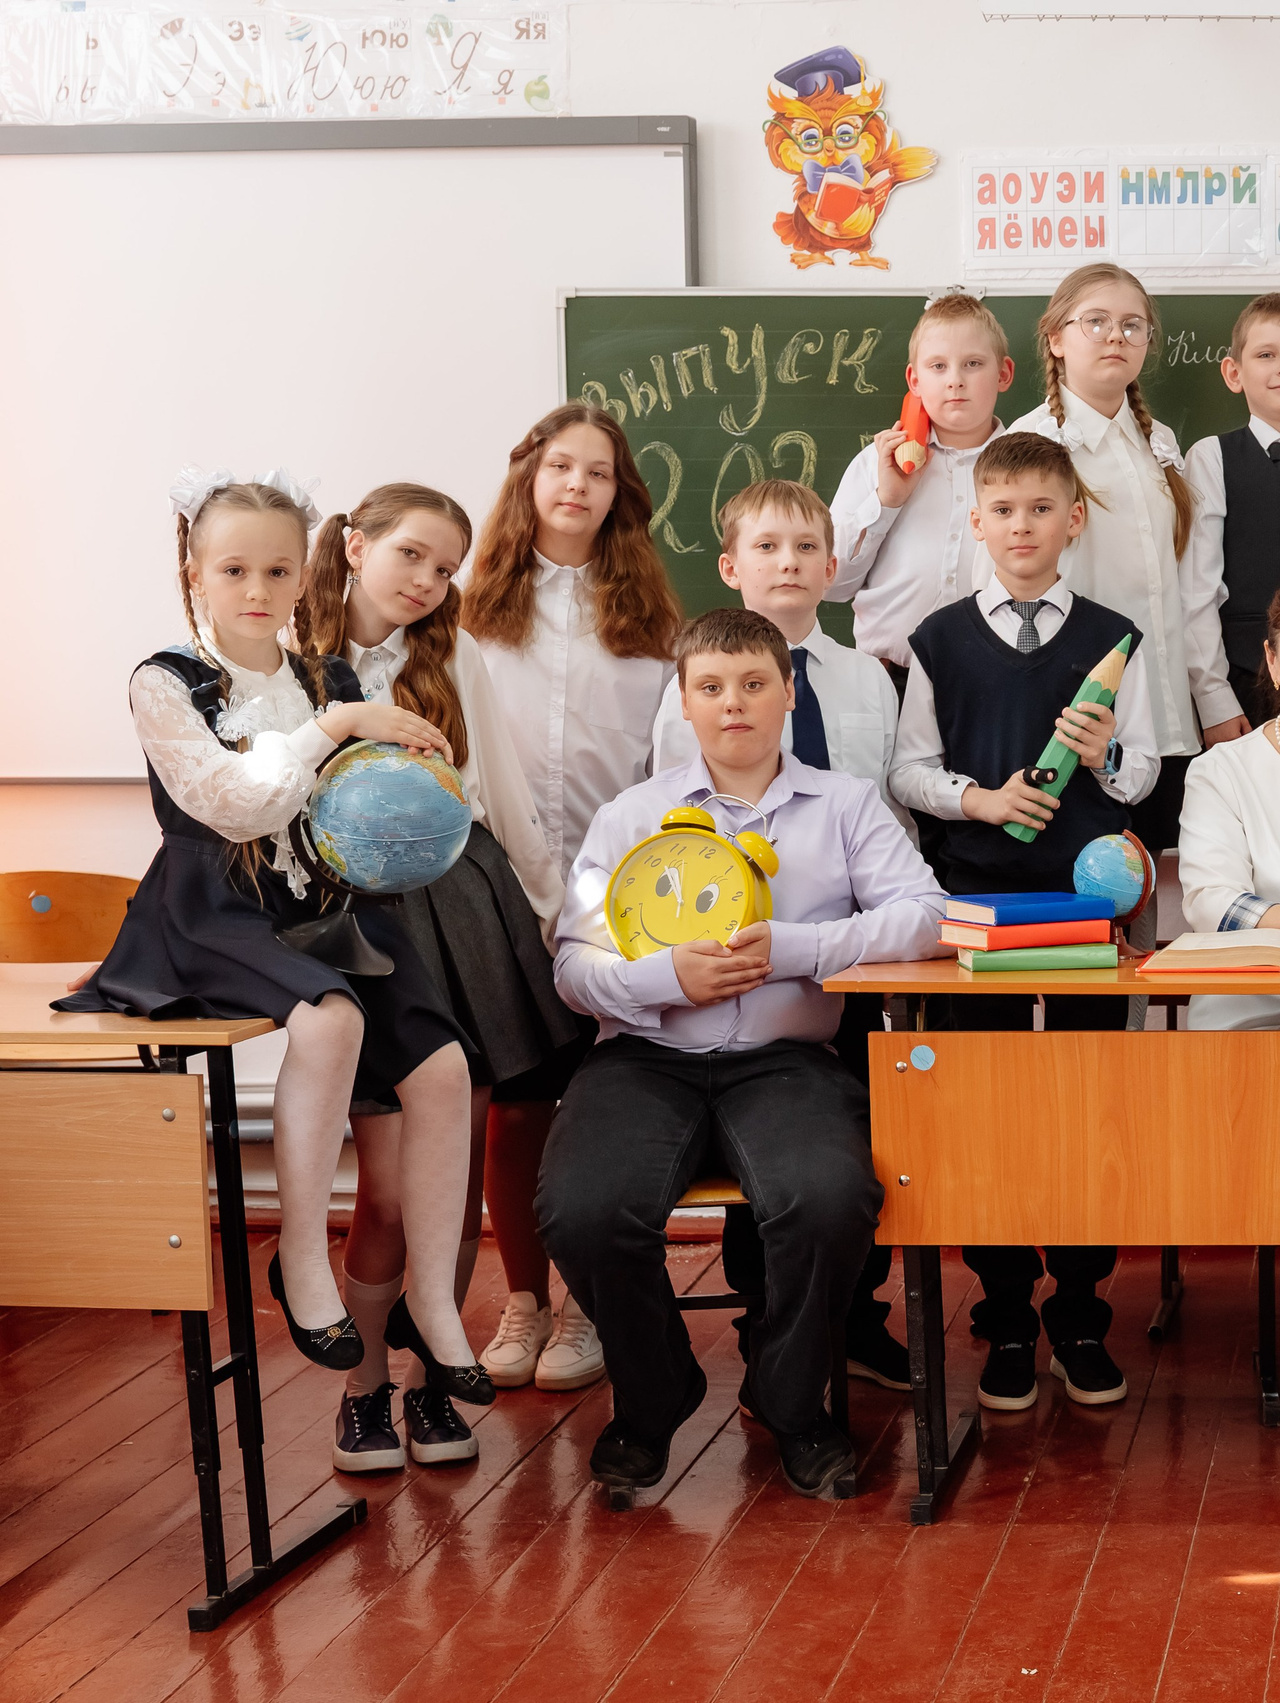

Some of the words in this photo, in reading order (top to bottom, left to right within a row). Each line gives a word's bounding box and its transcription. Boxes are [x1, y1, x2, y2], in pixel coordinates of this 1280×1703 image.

[669, 843, 687, 856] 11
[698, 846, 717, 860] 12
[643, 854, 662, 868] 10
[624, 877, 636, 888] 9
[731, 891, 744, 901] 2
[620, 906, 633, 918] 8
[724, 919, 738, 931] 3
[629, 931, 641, 943] 7
